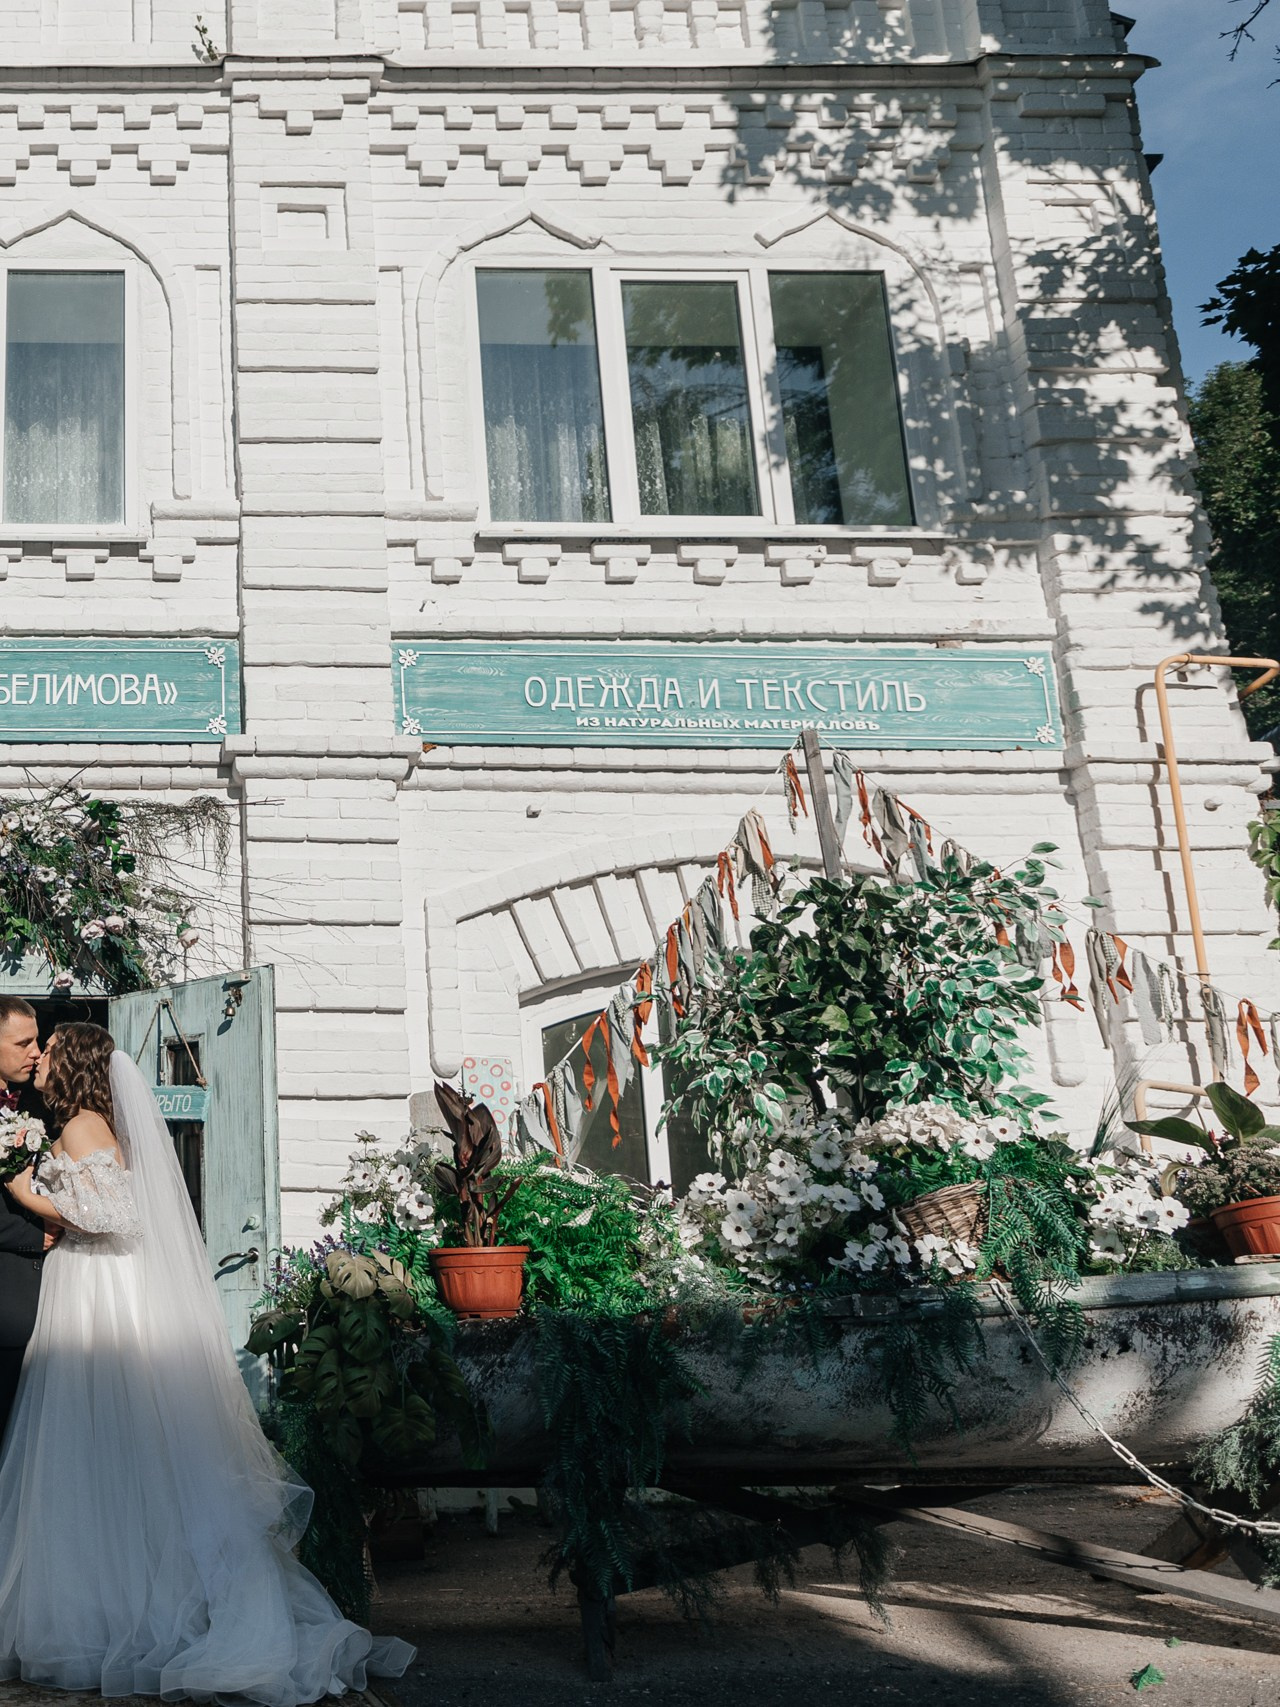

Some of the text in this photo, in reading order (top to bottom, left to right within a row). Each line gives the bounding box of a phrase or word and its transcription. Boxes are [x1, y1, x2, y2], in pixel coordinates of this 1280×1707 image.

[524, 676, 927, 713] ОДЕЖДА И ТЕКСТИЛЬ
[576, 717, 881, 730] ИЗ НАТУРАЛЬНЫХ МАТЕРИАЛОВЪ
